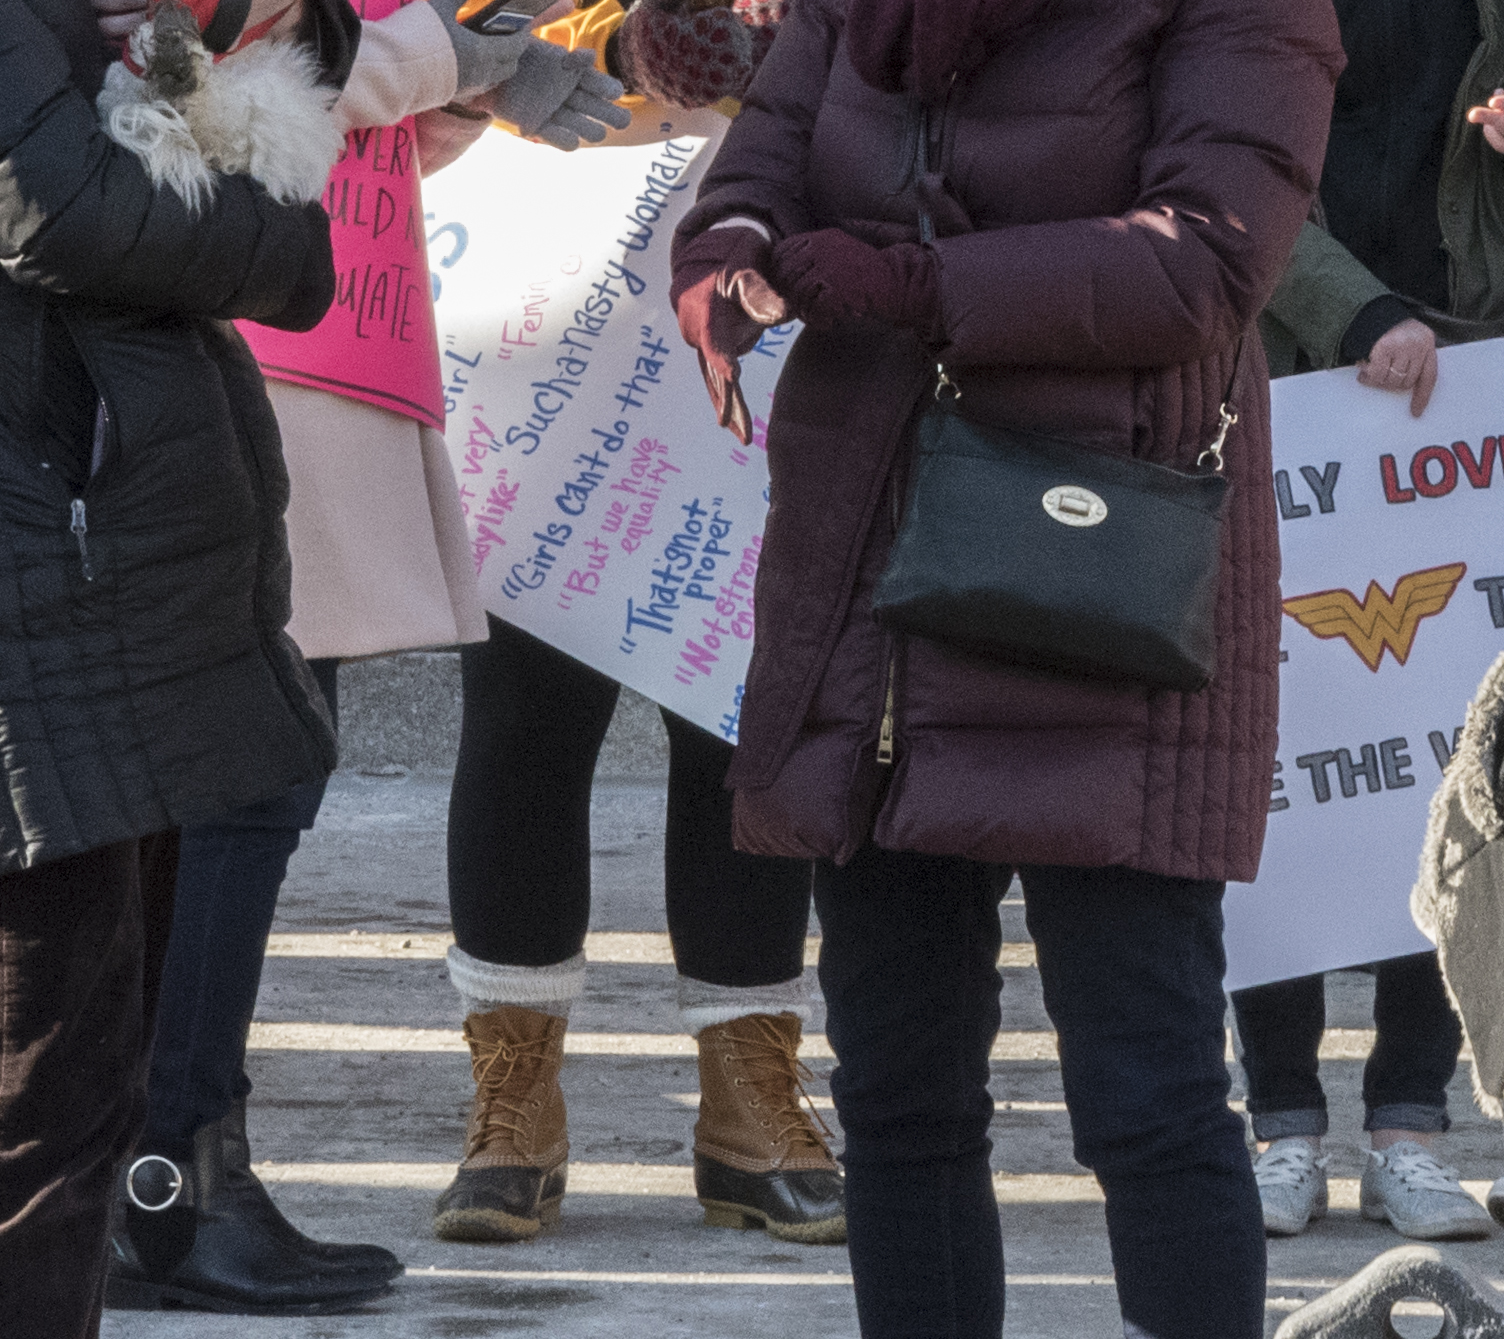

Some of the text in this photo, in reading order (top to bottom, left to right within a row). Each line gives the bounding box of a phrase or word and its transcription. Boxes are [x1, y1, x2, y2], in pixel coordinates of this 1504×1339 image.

[336, 261, 422, 343] ULATE
[591, 418, 631, 454] do
[1274, 460, 1343, 520] LY
[1296, 735, 1416, 804] THE
